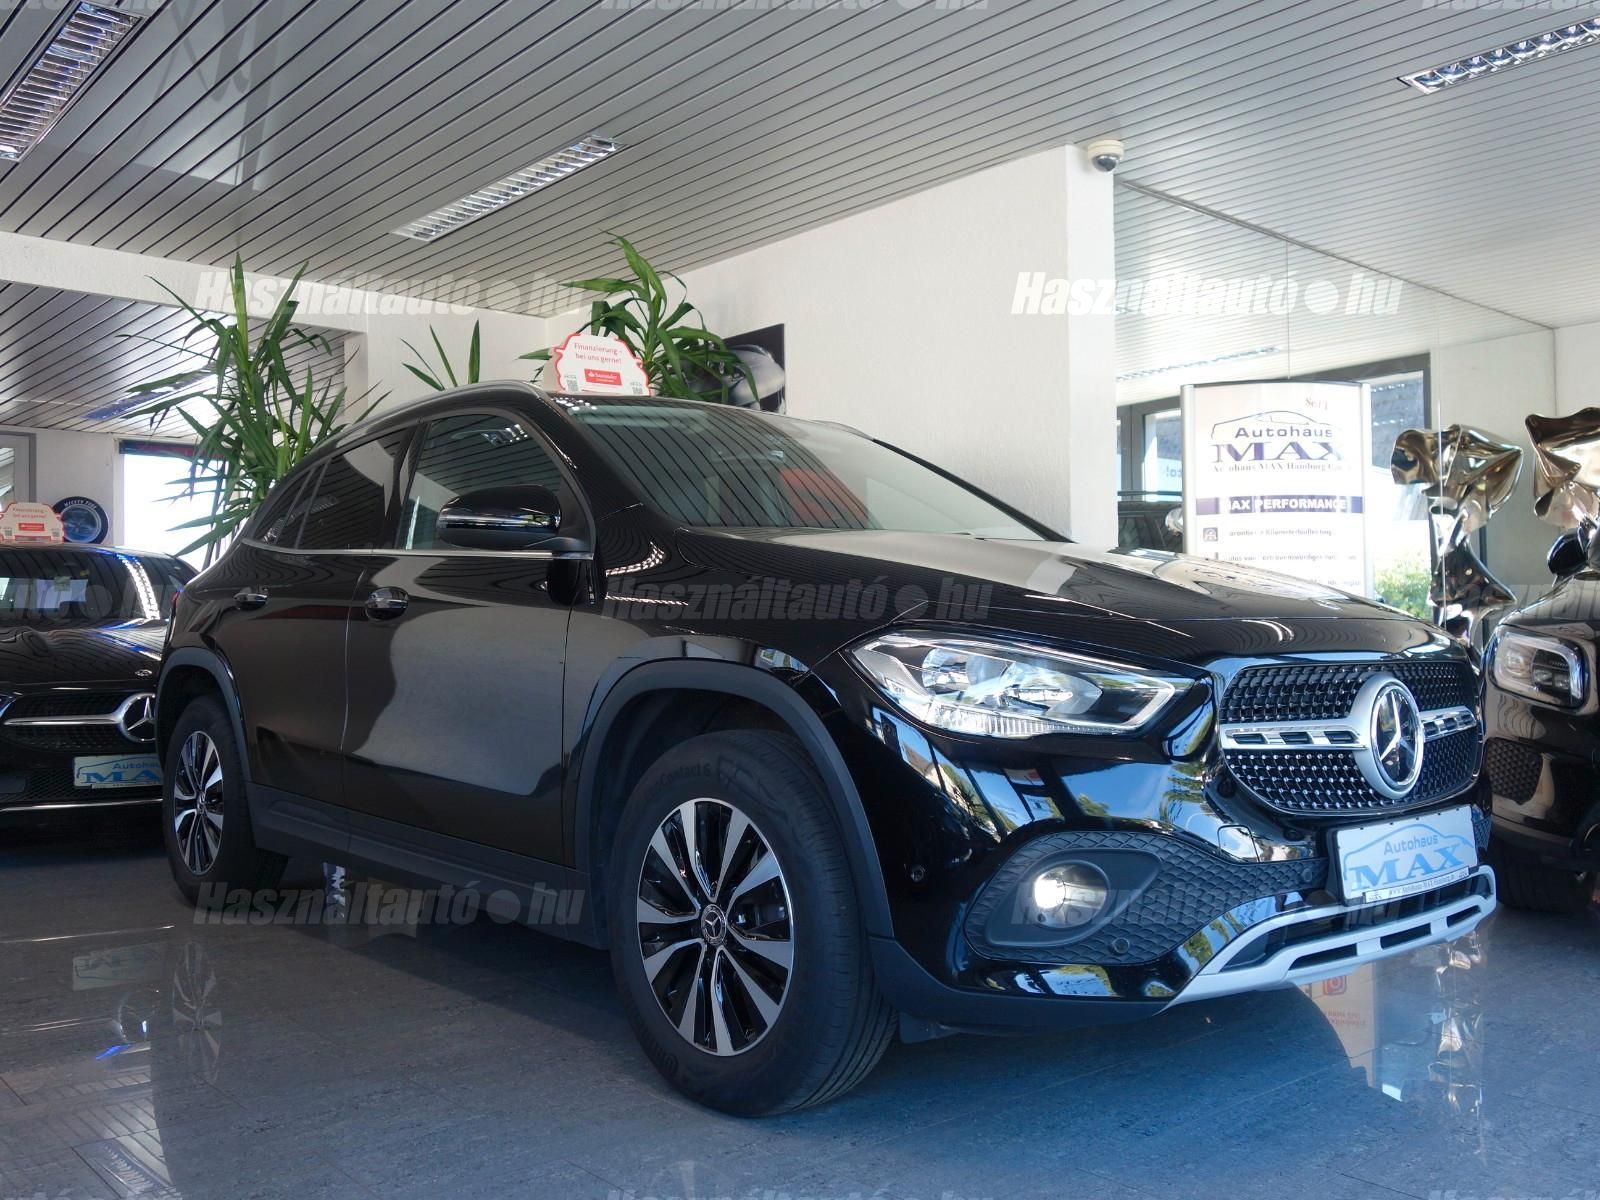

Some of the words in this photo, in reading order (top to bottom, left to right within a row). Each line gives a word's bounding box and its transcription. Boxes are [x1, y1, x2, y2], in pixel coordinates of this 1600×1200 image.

[1234, 426, 1333, 439] Autohaus
[1210, 441, 1343, 464] MAX
[1223, 498, 1251, 511] AX
[1254, 497, 1347, 510] PERFORMANCE
[81, 769, 162, 784] MA
[1384, 834, 1440, 856] Autohaus
[1349, 842, 1465, 892] MAX
